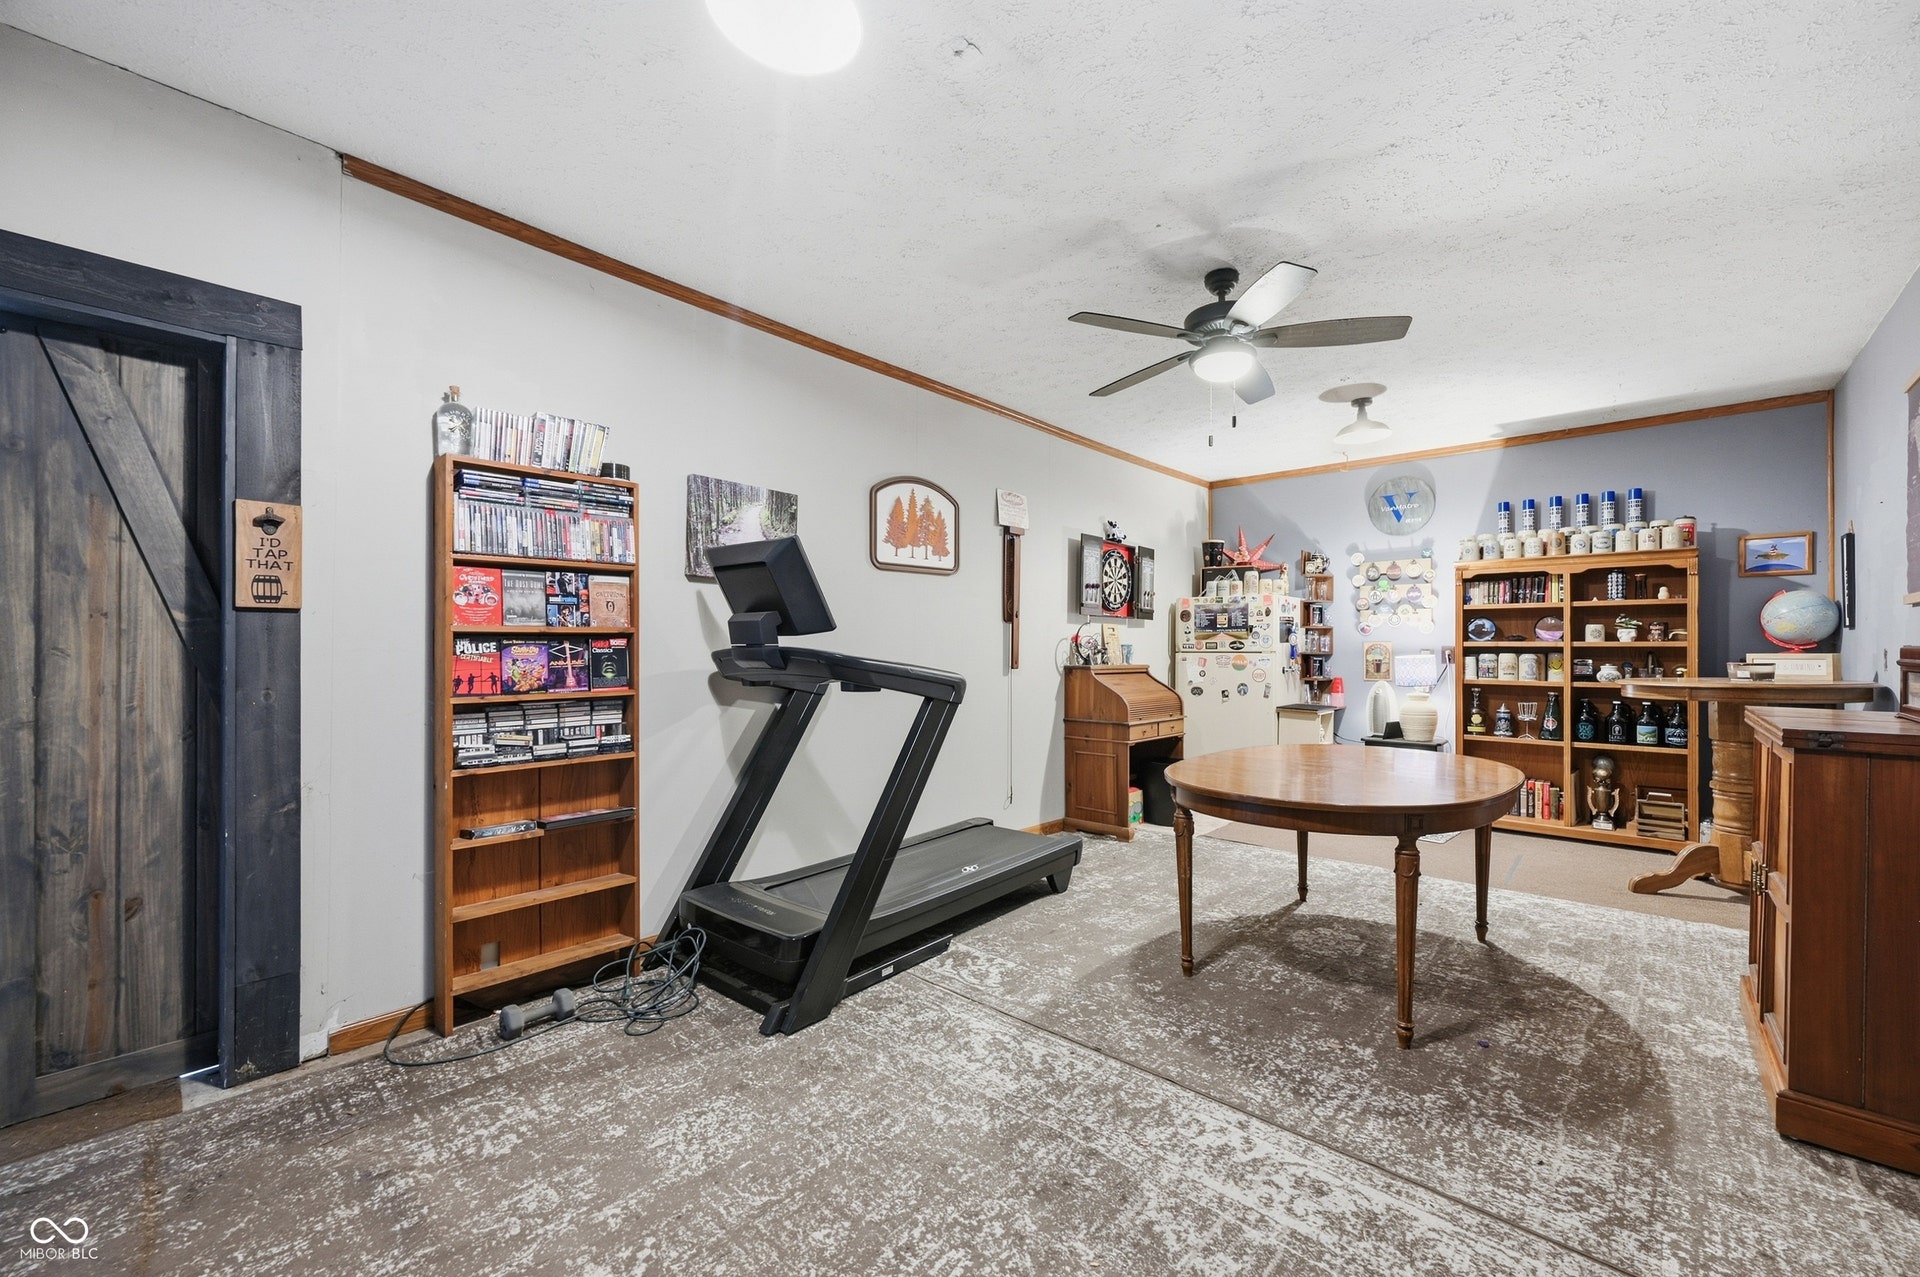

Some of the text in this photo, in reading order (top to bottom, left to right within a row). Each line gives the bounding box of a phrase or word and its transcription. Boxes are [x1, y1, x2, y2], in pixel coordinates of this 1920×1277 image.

[259, 537, 281, 548] I'D
[252, 547, 288, 560] TAP
[245, 558, 294, 571] THAT
[455, 642, 497, 656] POLICE
